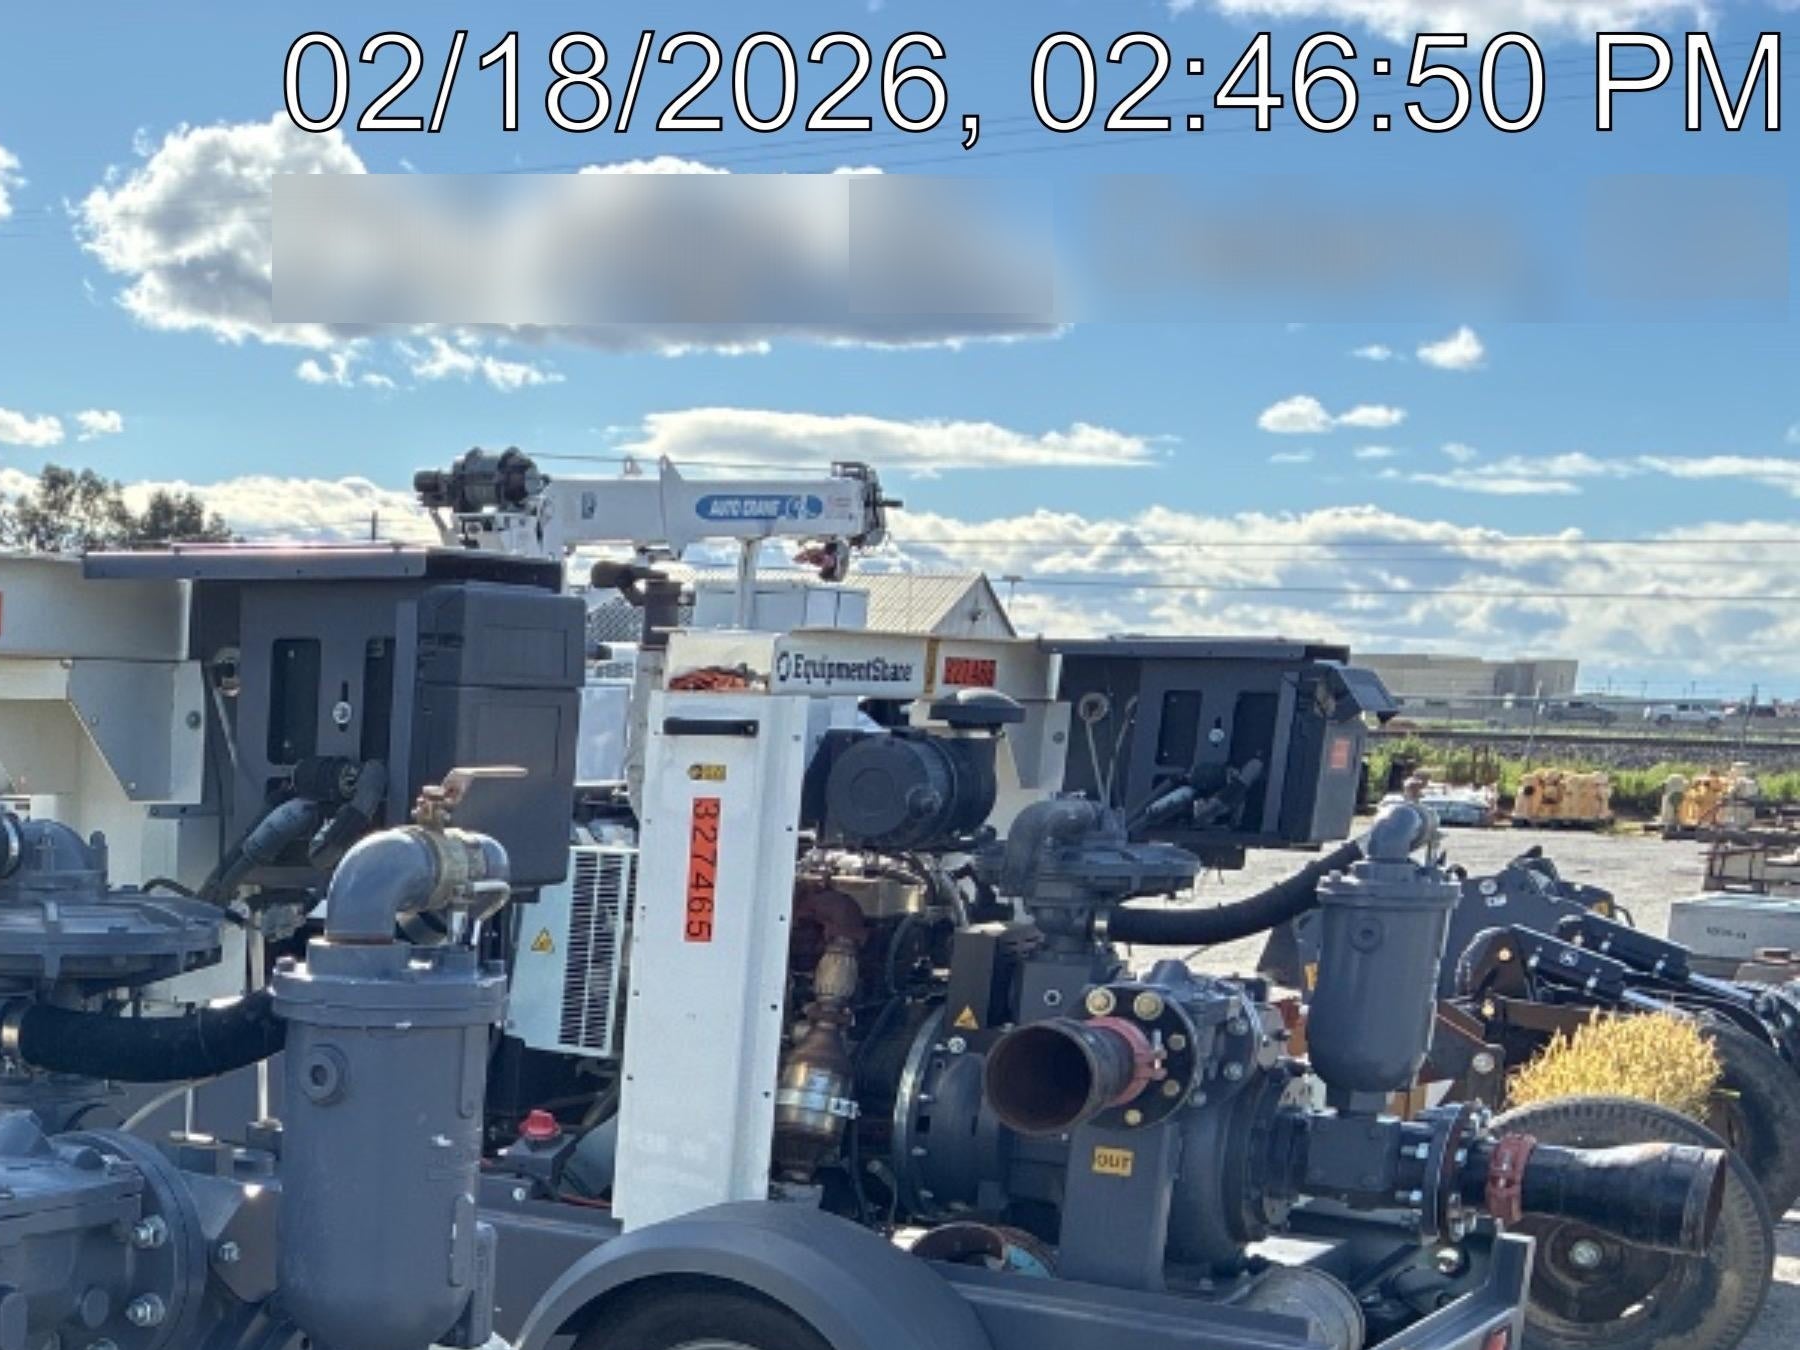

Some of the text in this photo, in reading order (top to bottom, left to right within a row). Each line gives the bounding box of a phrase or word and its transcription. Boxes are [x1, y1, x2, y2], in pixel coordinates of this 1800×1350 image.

[793, 652, 913, 685] EquipmentShare
[686, 798, 720, 938] 327465
[1096, 1153, 1130, 1169] OUT
